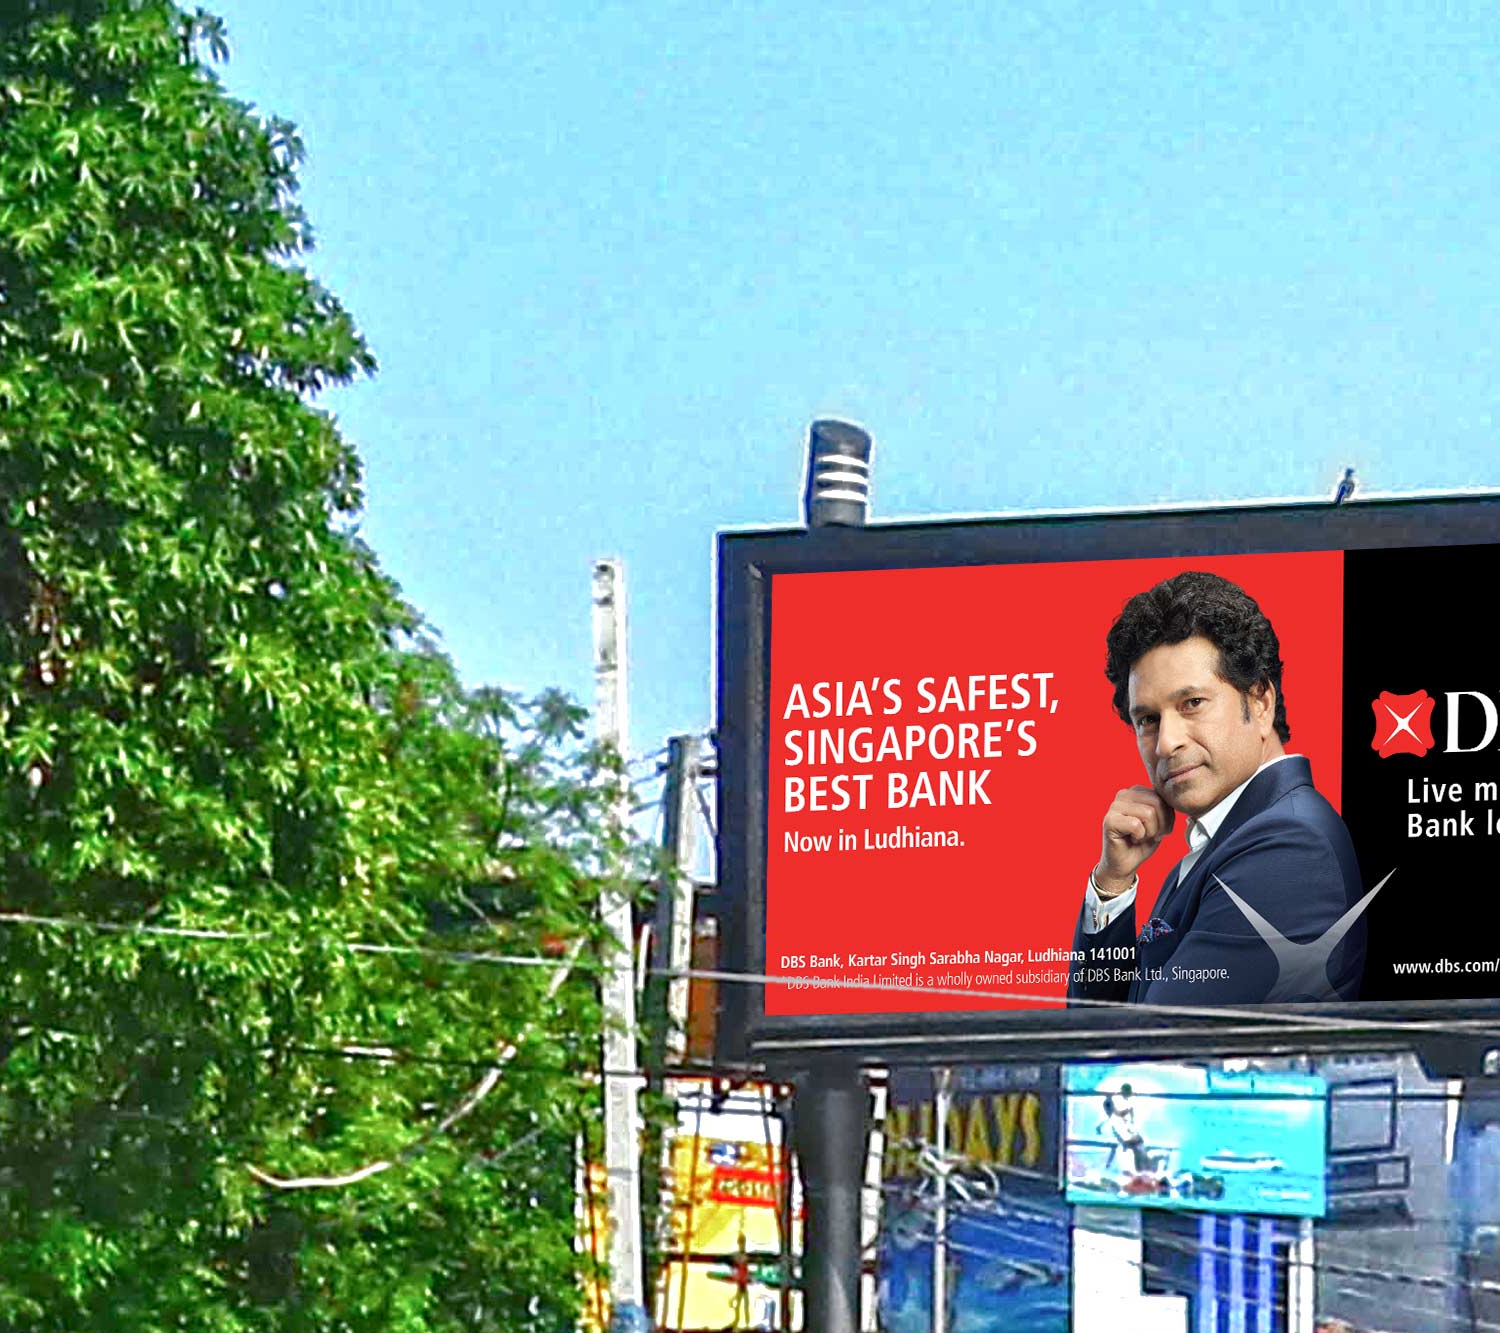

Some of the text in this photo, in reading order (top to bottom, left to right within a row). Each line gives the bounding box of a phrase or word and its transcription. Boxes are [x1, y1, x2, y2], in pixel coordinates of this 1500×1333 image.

[783, 672, 1058, 719] ASIA'S SAFEST,
[784, 719, 1037, 766] SINGAPORE'S
[785, 769, 992, 813] BEST BANK
[1408, 778, 1462, 804] Live
[1408, 810, 1474, 838] Bank
[784, 826, 965, 853] Now in Ludhiana.
[781, 946, 1136, 969] DBS Bank, Kartar Singh Sarabha Nagar, Ludhiana 141001
[873, 972, 913, 988] Limited
[915, 972, 925, 986] is
[926, 975, 935, 986] a
[936, 971, 973, 989] wholly
[975, 970, 1013, 985] owned
[1015, 968, 1070, 986] subsidiary
[1073, 967, 1086, 983] of
[1088, 967, 1111, 982] DBS
[1113, 966, 1142, 982] Bank
[1145, 966, 1169, 983] Ltd.,
[1172, 966, 1230, 983] Singapore.
